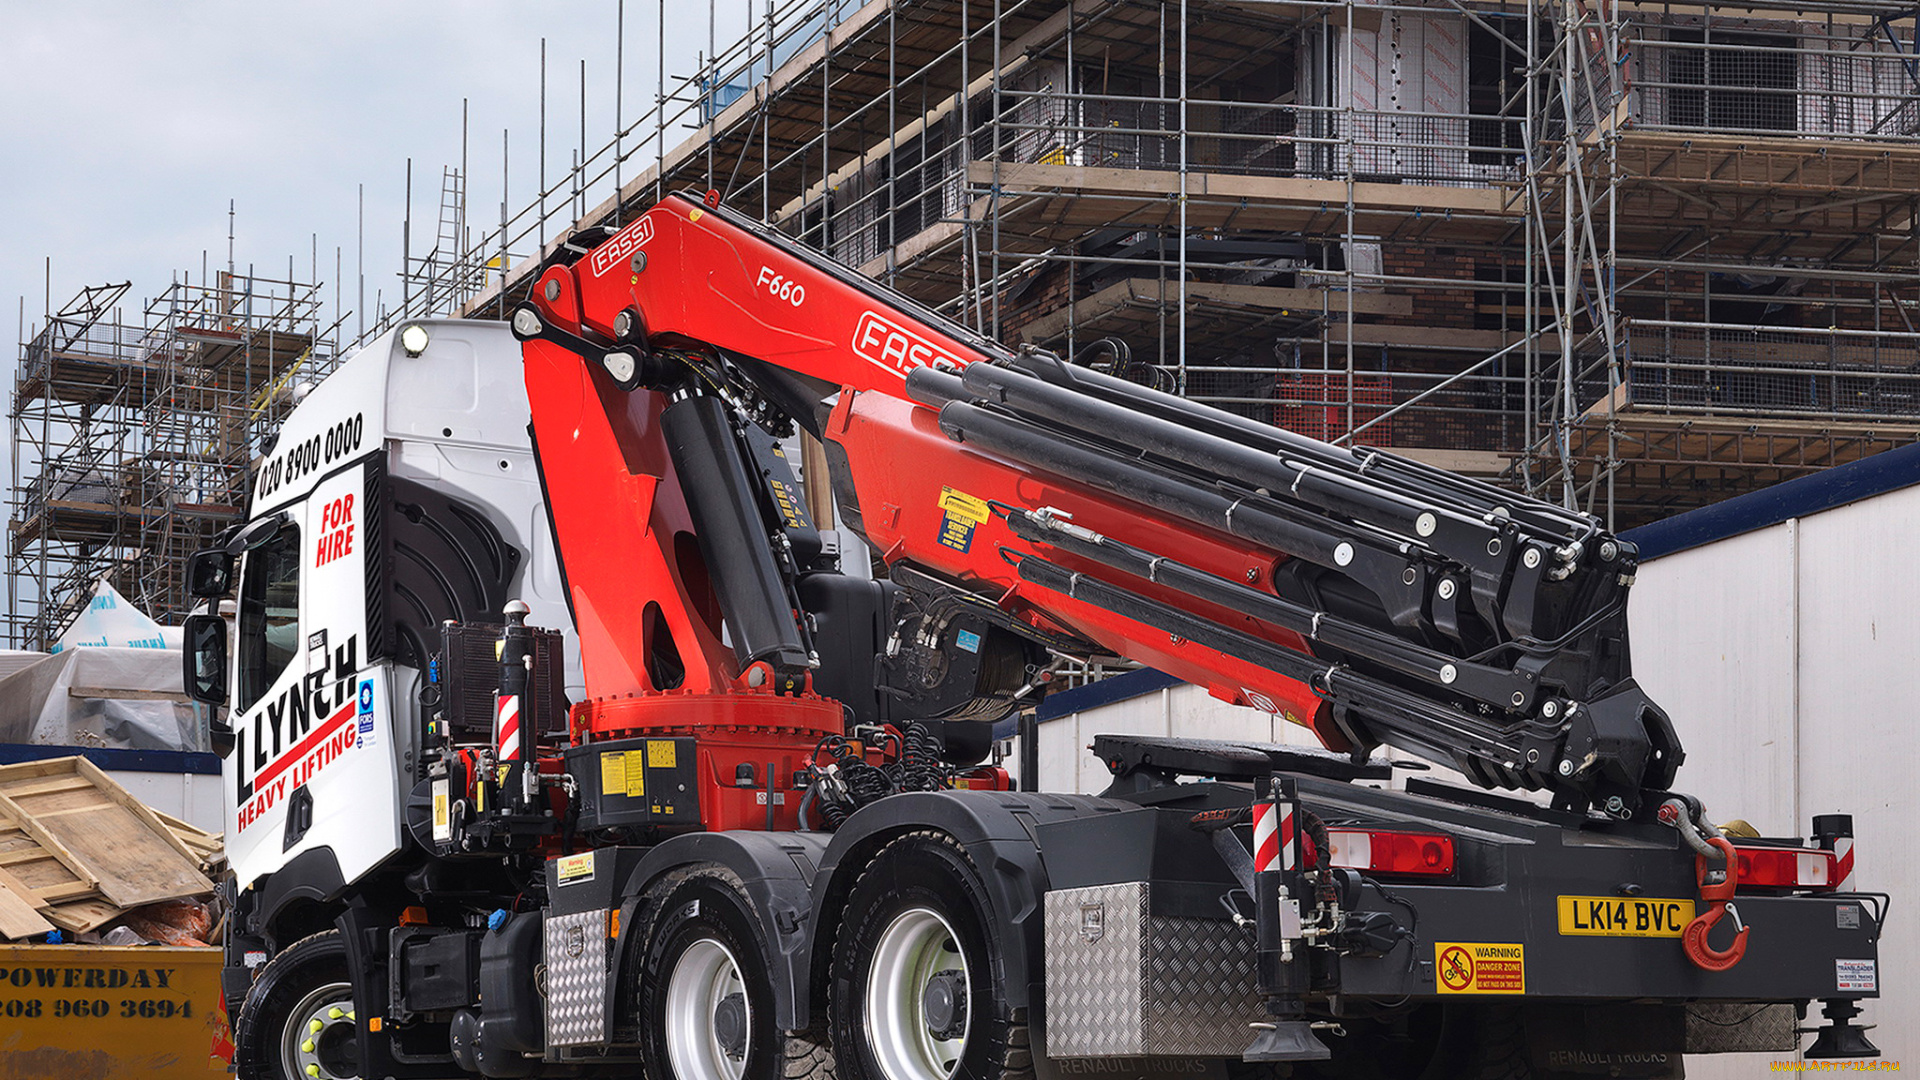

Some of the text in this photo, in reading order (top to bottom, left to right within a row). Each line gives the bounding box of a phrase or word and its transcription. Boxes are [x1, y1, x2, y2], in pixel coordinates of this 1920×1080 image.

[596, 221, 650, 270] FASSI
[757, 266, 805, 307] F660
[259, 412, 363, 501] 020 8900 0000
[320, 493, 354, 535] FOR
[315, 524, 355, 569] HIRE
[359, 714, 373, 725] FORS
[237, 723, 357, 834] HEAVY LIFTING
[658, 904, 696, 947] WORKS
[1573, 900, 1682, 931] LK14 BVC
[1475, 947, 1521, 958] WARNING
[1477, 963, 1521, 972] DANGER ZONE
[54, 999, 110, 1018] 960
[120, 999, 193, 1018] 3694
[1059, 1059, 1207, 1074] RENAULT TRUCKS
